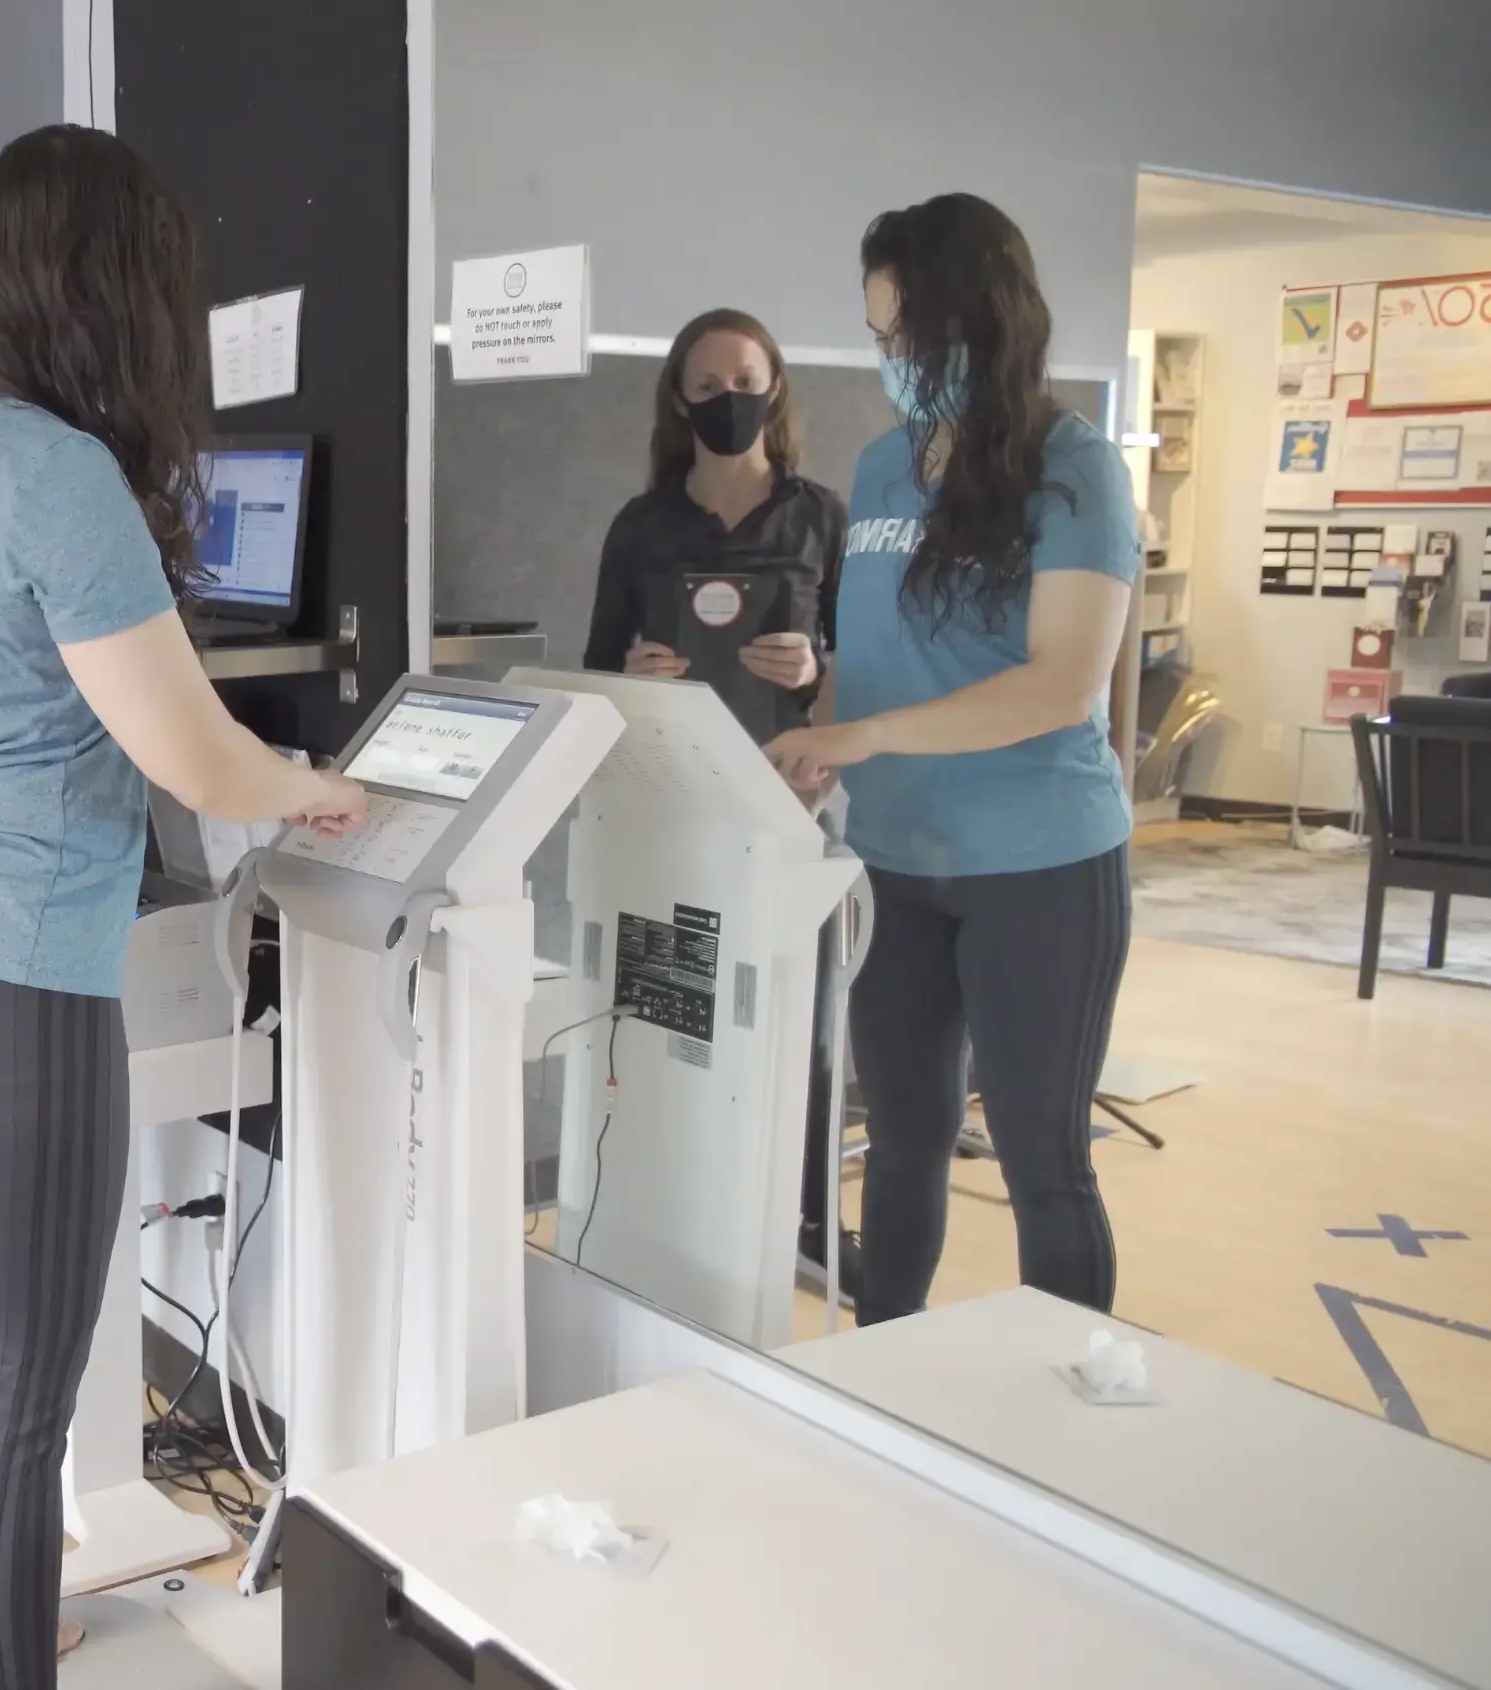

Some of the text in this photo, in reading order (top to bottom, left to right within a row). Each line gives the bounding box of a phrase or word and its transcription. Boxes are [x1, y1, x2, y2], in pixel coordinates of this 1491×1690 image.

[467, 300, 562, 319] For your own safety, please
[475, 317, 553, 333] do NOT touch or apply
[472, 333, 556, 350] pressure on the mirrors.
[497, 356, 529, 365] THANK YOU
